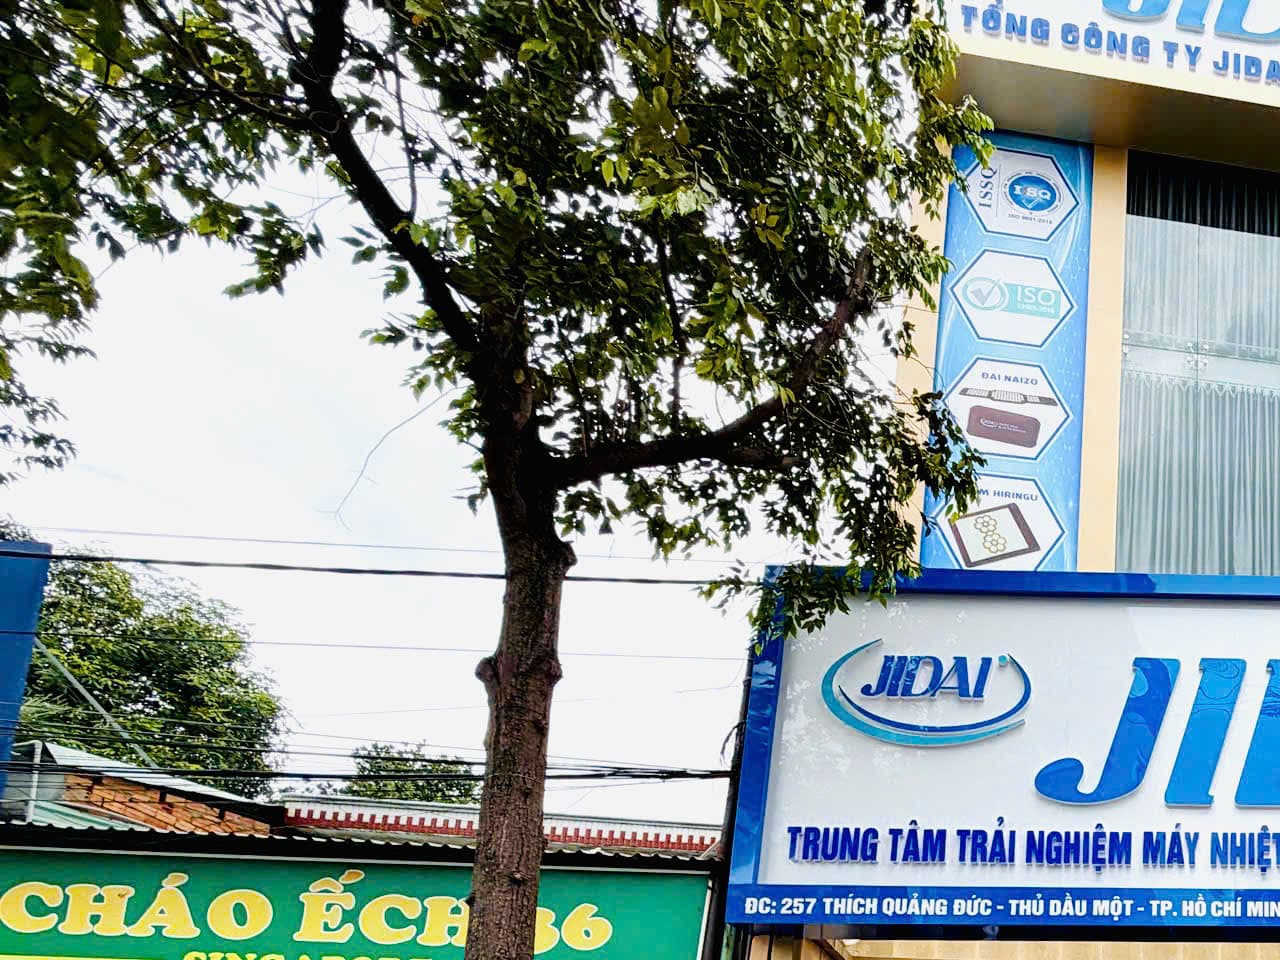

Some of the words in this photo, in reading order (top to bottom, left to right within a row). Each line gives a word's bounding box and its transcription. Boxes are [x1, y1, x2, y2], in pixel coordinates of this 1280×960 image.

[961, 0, 1050, 43] TỔNG
[1061, 22, 1150, 60] CÔNG
[1163, 41, 1202, 69] TY
[1016, 285, 1055, 305] ISO
[1004, 375, 1038, 385] NAIZO
[993, 489, 1039, 501] HIRINGU
[861, 655, 992, 699] JIDAI
[787, 826, 878, 863] TRUNG
[888, 819, 946, 865] TÂM
[956, 817, 1015, 866] TRẢI
[1025, 824, 1131, 873] NGHIỆM
[1142, 824, 1199, 867] MÁY
[0, 872, 274, 941] CHÁO
[293, 869, 471, 948] ẾCH
[744, 897, 777, 914] ĐC:
[780, 897, 817, 914] 257
[822, 893, 878, 915] THÍCH
[882, 893, 948, 917] QUẢNG
[953, 894, 992, 917] ĐỨC
[1009, 893, 1044, 917] THỦ
[1049, 893, 1088, 917] DẦU
[1092, 896, 1134, 921] MỘT
[1149, 900, 1178, 917] TP.
[1182, 893, 1206, 917] HỒ
[1210, 897, 1242, 918] CHÍ
